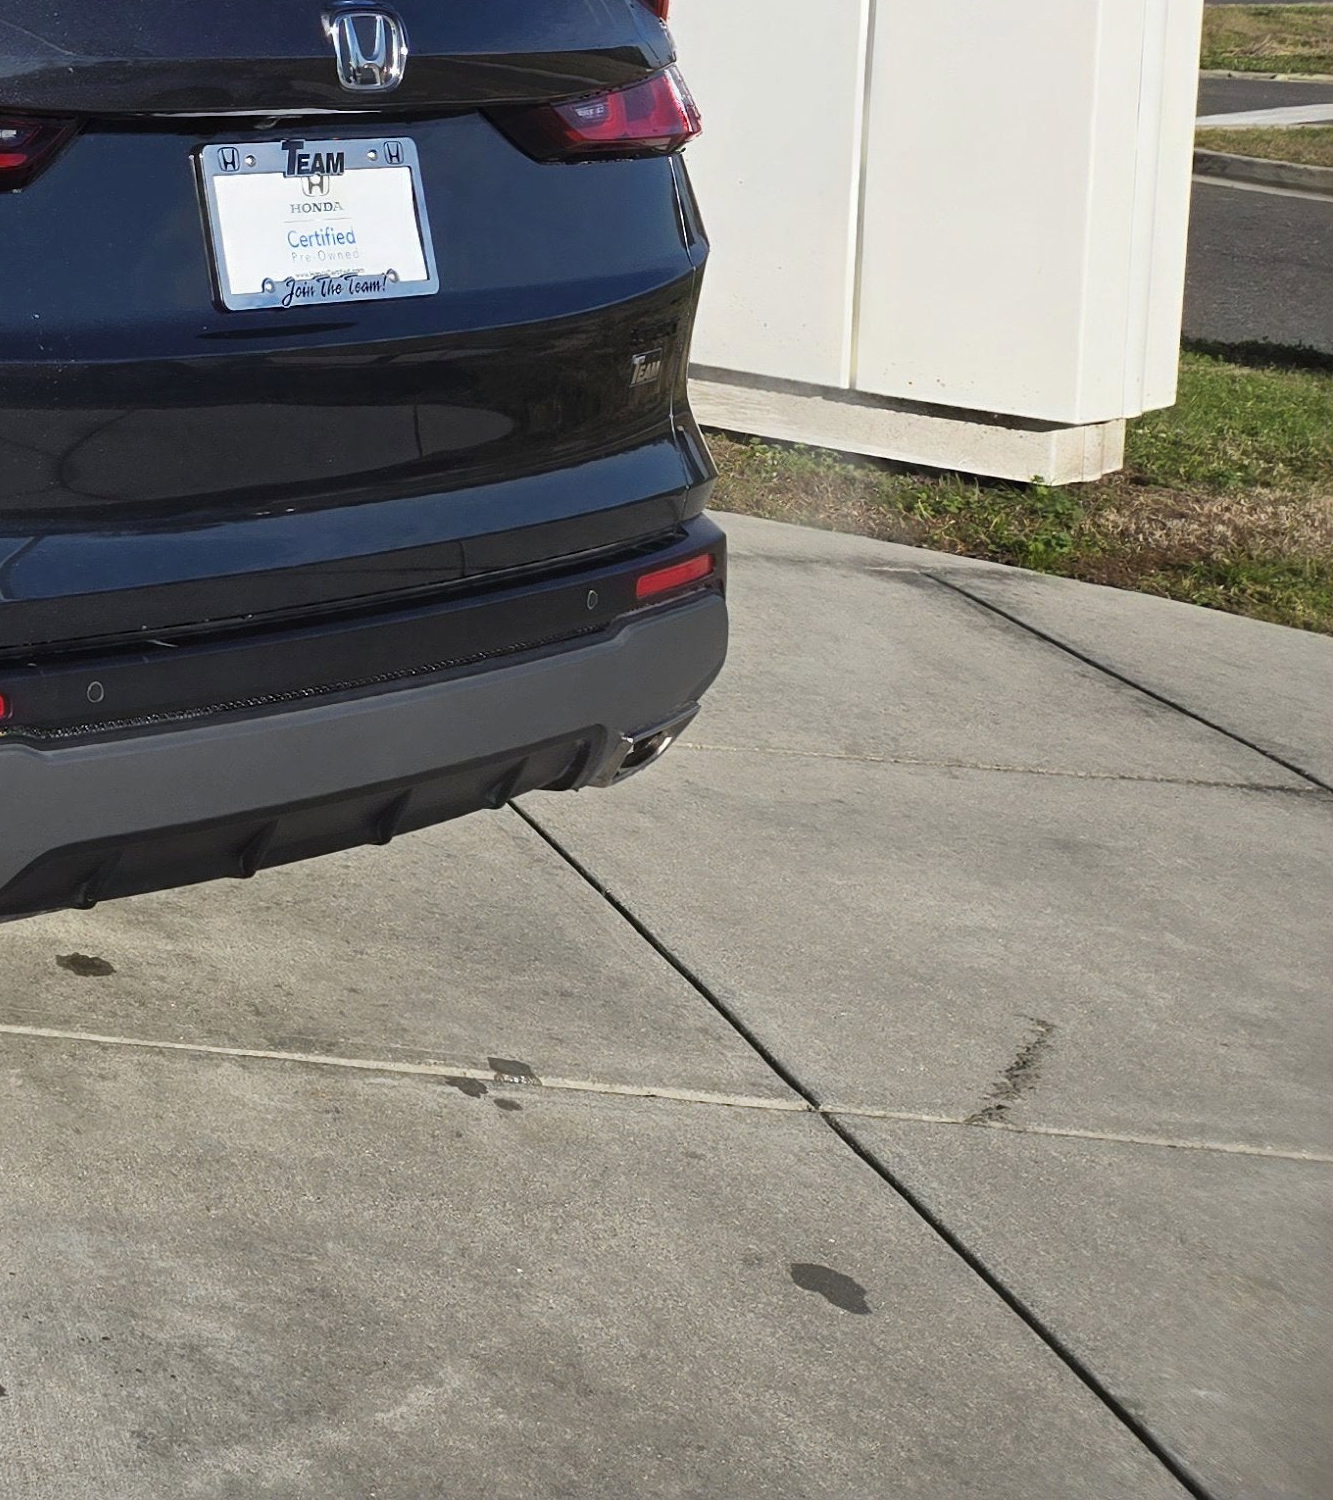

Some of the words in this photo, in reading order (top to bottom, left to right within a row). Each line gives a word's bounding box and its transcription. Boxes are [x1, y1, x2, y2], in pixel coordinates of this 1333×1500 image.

[281, 140, 345, 177] TEAM
[290, 201, 344, 214] HONDA
[287, 226, 356, 248] Certified
[282, 276, 316, 307] Join
[311, 274, 343, 298] The
[340, 271, 387, 296] Team!
